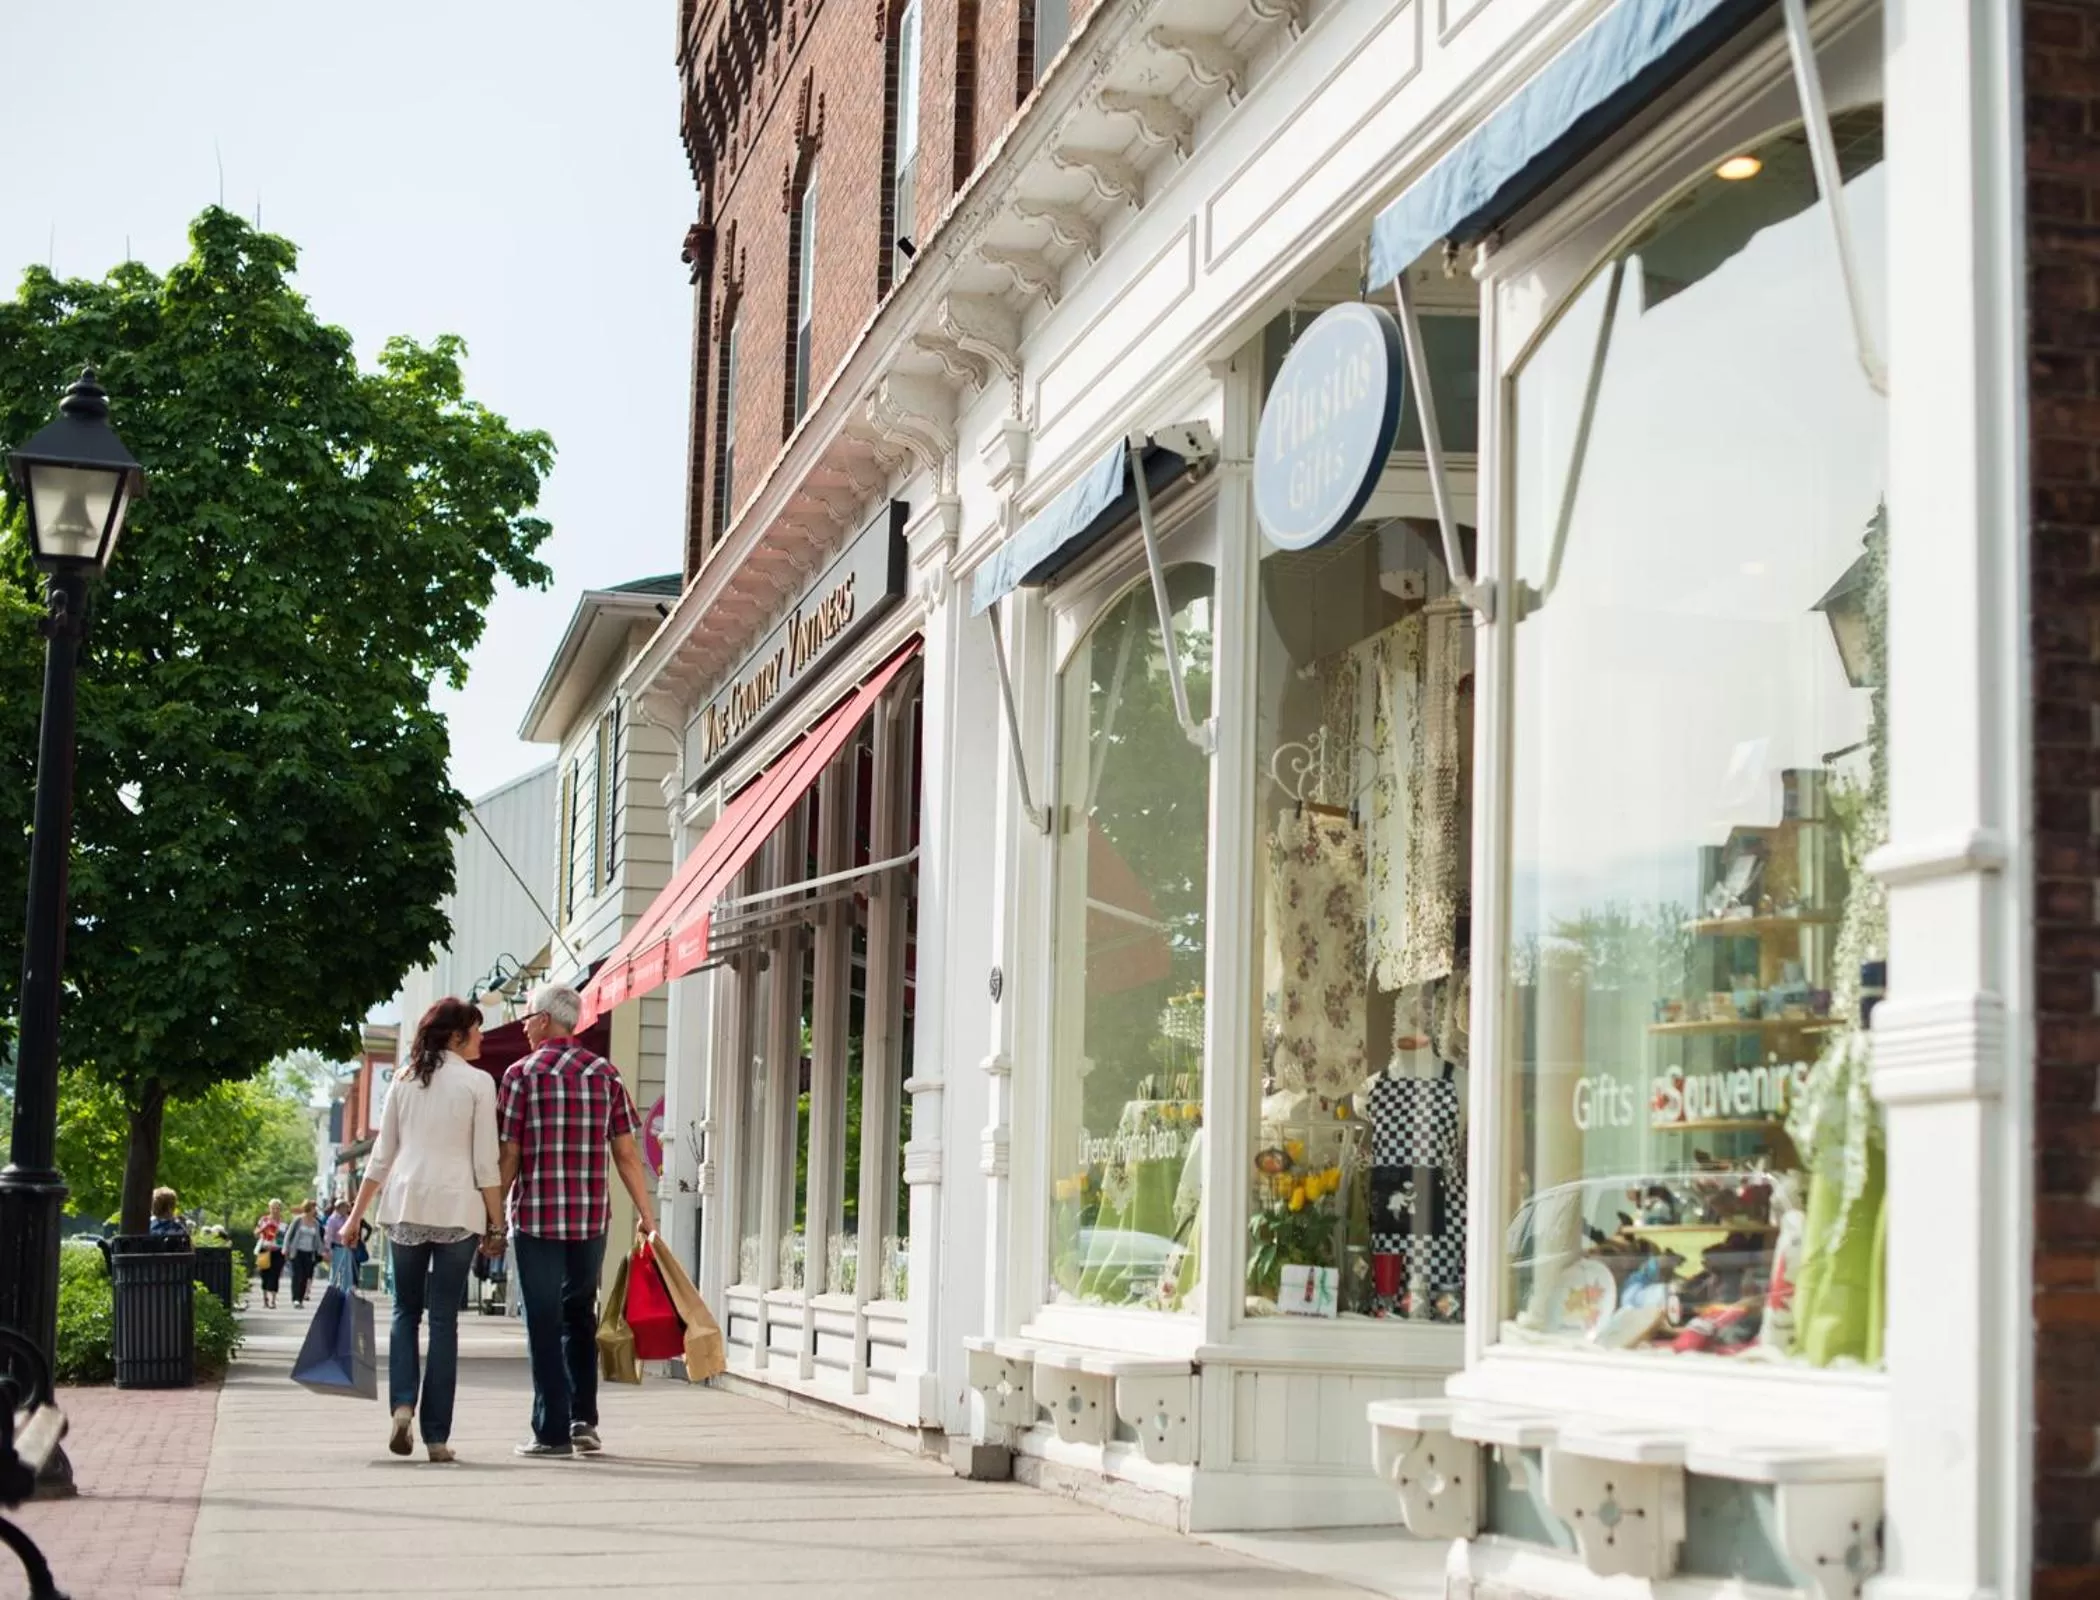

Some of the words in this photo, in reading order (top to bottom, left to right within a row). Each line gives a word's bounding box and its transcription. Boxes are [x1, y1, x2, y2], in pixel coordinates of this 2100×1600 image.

[1288, 441, 1346, 514] Gifts
[730, 647, 784, 737] COUNTRY
[786, 571, 855, 678] VINTNERS
[1572, 1072, 1635, 1131] Gifts
